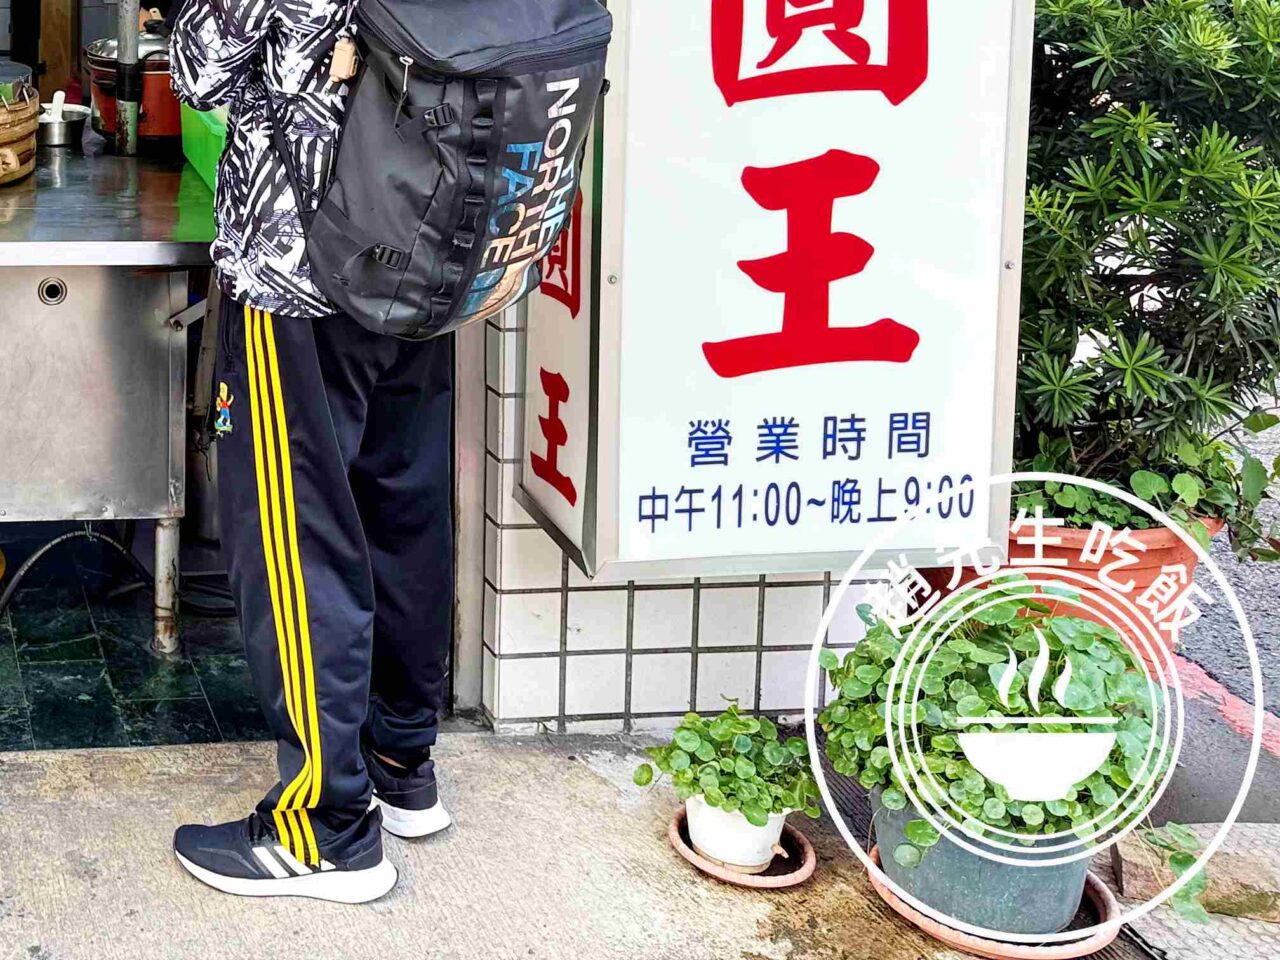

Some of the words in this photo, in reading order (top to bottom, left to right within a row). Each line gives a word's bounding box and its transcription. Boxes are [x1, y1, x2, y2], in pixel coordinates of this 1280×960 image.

[482, 140, 544, 270] FACE
[509, 77, 580, 263] NORTH
[688, 412, 931, 468] 營業時間
